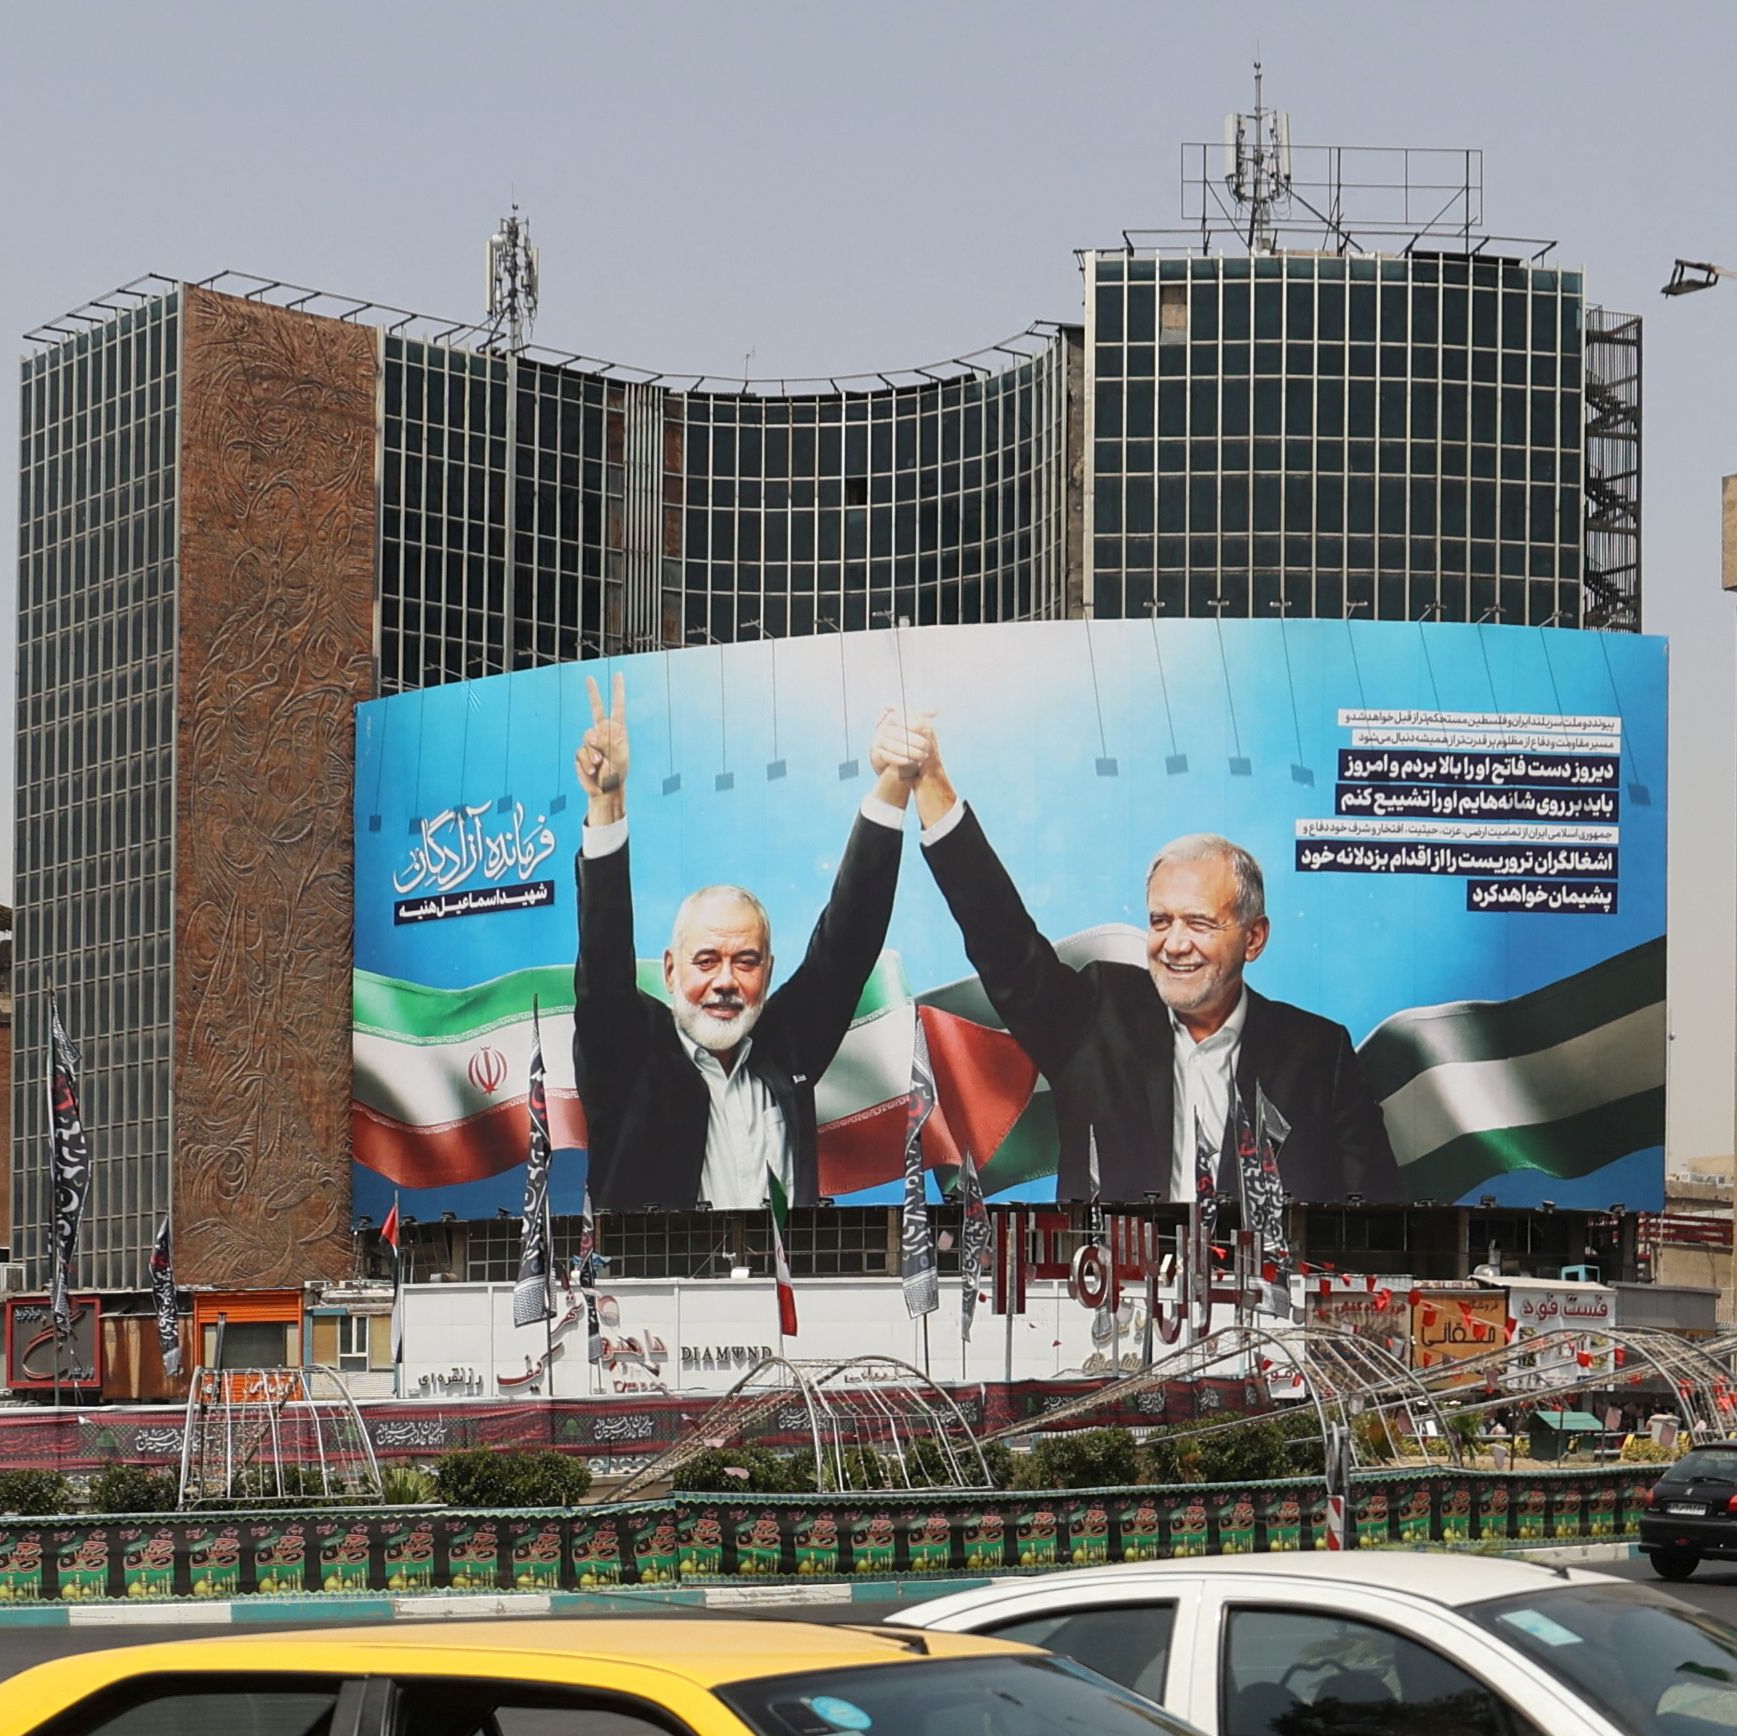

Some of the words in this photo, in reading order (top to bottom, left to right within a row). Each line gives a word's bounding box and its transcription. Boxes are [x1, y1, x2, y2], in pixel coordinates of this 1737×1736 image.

[1344, 753, 1389, 778] امروز
[1400, 758, 1438, 779] بردم
[1438, 755, 1462, 780] بالا
[1492, 754, 1527, 784] فاتح
[1527, 761, 1572, 779] دست
[1571, 762, 1614, 784] دیروز
[1340, 788, 1373, 811] کنم
[1373, 787, 1431, 815] تشییع
[1583, 793, 1613, 818] باید
[1301, 845, 1335, 869] خود
[1336, 846, 1389, 871] بزدلانه
[1389, 845, 1431, 872] اقدام
[1458, 851, 1534, 874] تروریست
[1534, 850, 1613, 875] اشغالگران
[436, 888, 500, 918] اسماعیل
[500, 882, 548, 907] شهید
[1472, 884, 1500, 907] کرد
[1498, 883, 1548, 908] خواهد
[1548, 885, 1612, 912] پشیمان
[399, 900, 437, 920] هنیه
[1522, 1292, 1562, 1321] فود
[1563, 1295, 1608, 1319] فست
